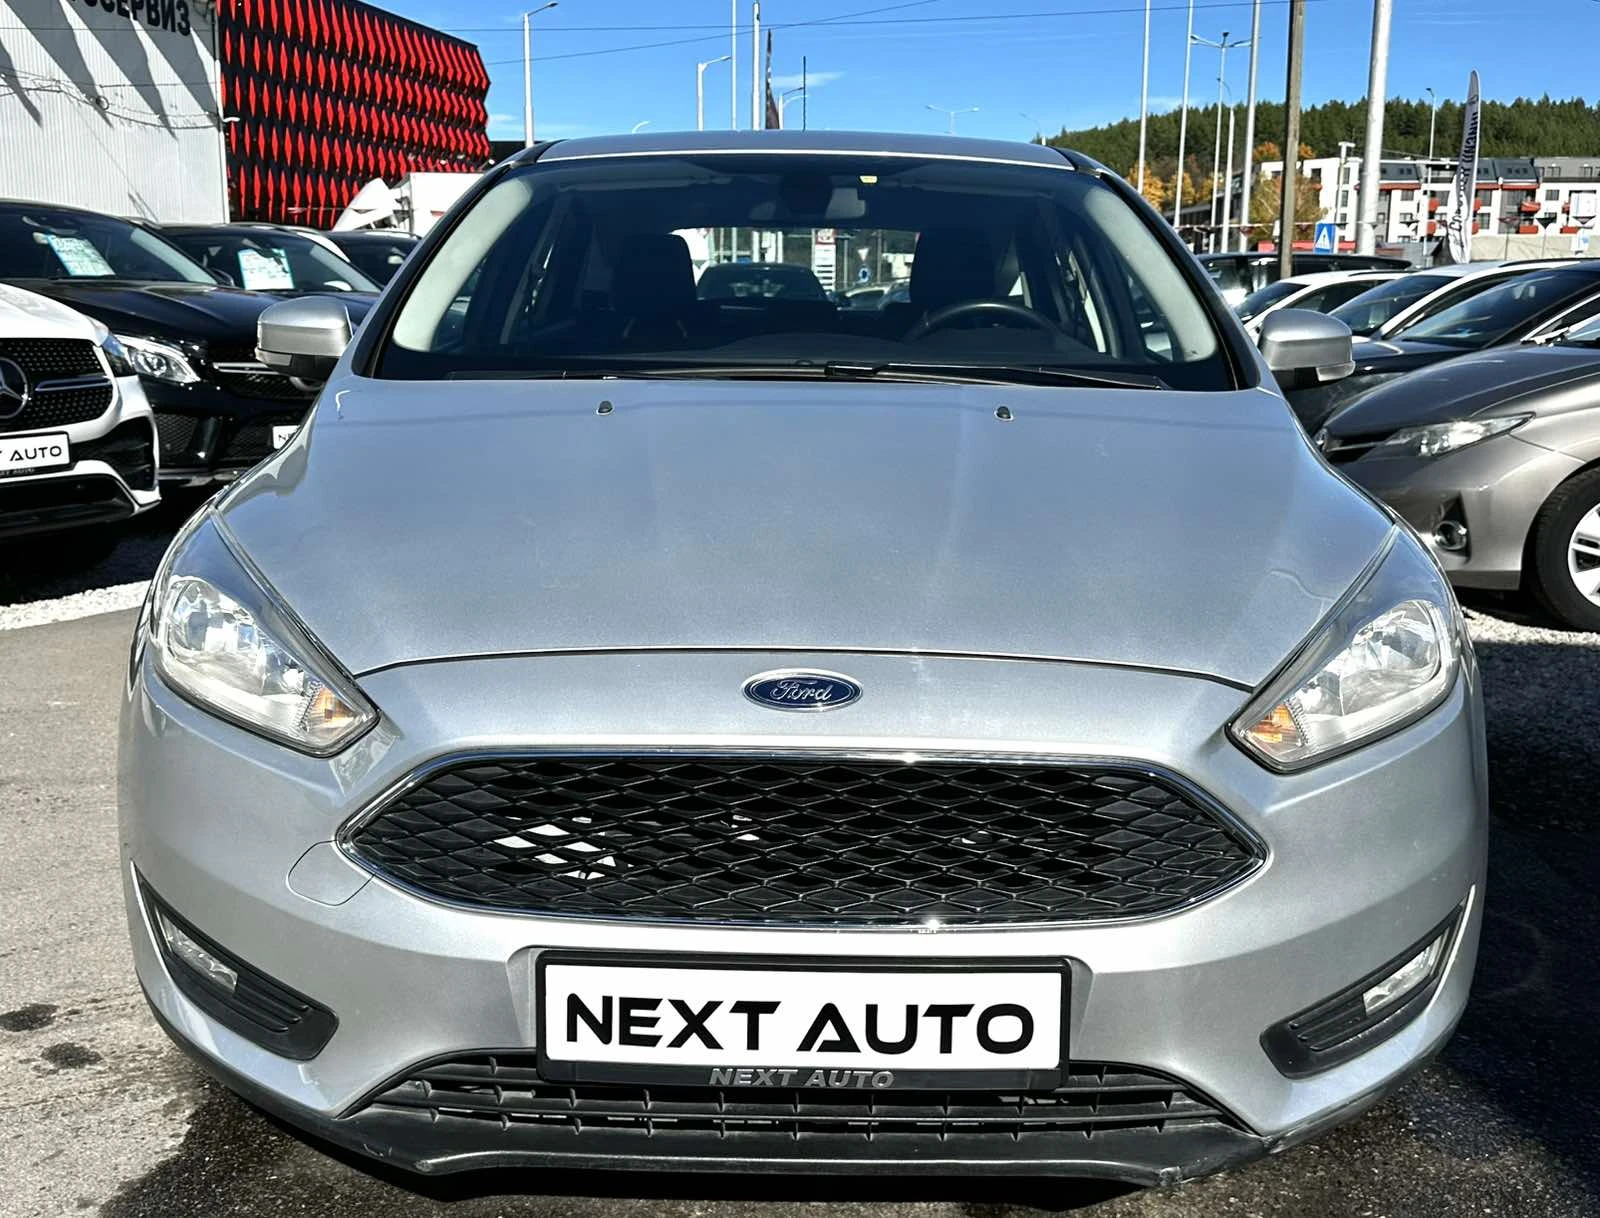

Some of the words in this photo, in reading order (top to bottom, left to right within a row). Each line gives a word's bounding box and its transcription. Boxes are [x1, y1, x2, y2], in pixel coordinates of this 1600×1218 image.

[9, 445, 62, 462] AUTO
[769, 678, 834, 701] Ford
[566, 993, 782, 1051] NEXT
[795, 1002, 1035, 1055] AUTO
[709, 1068, 799, 1087] NEXT
[803, 1069, 895, 1089] AUTO
